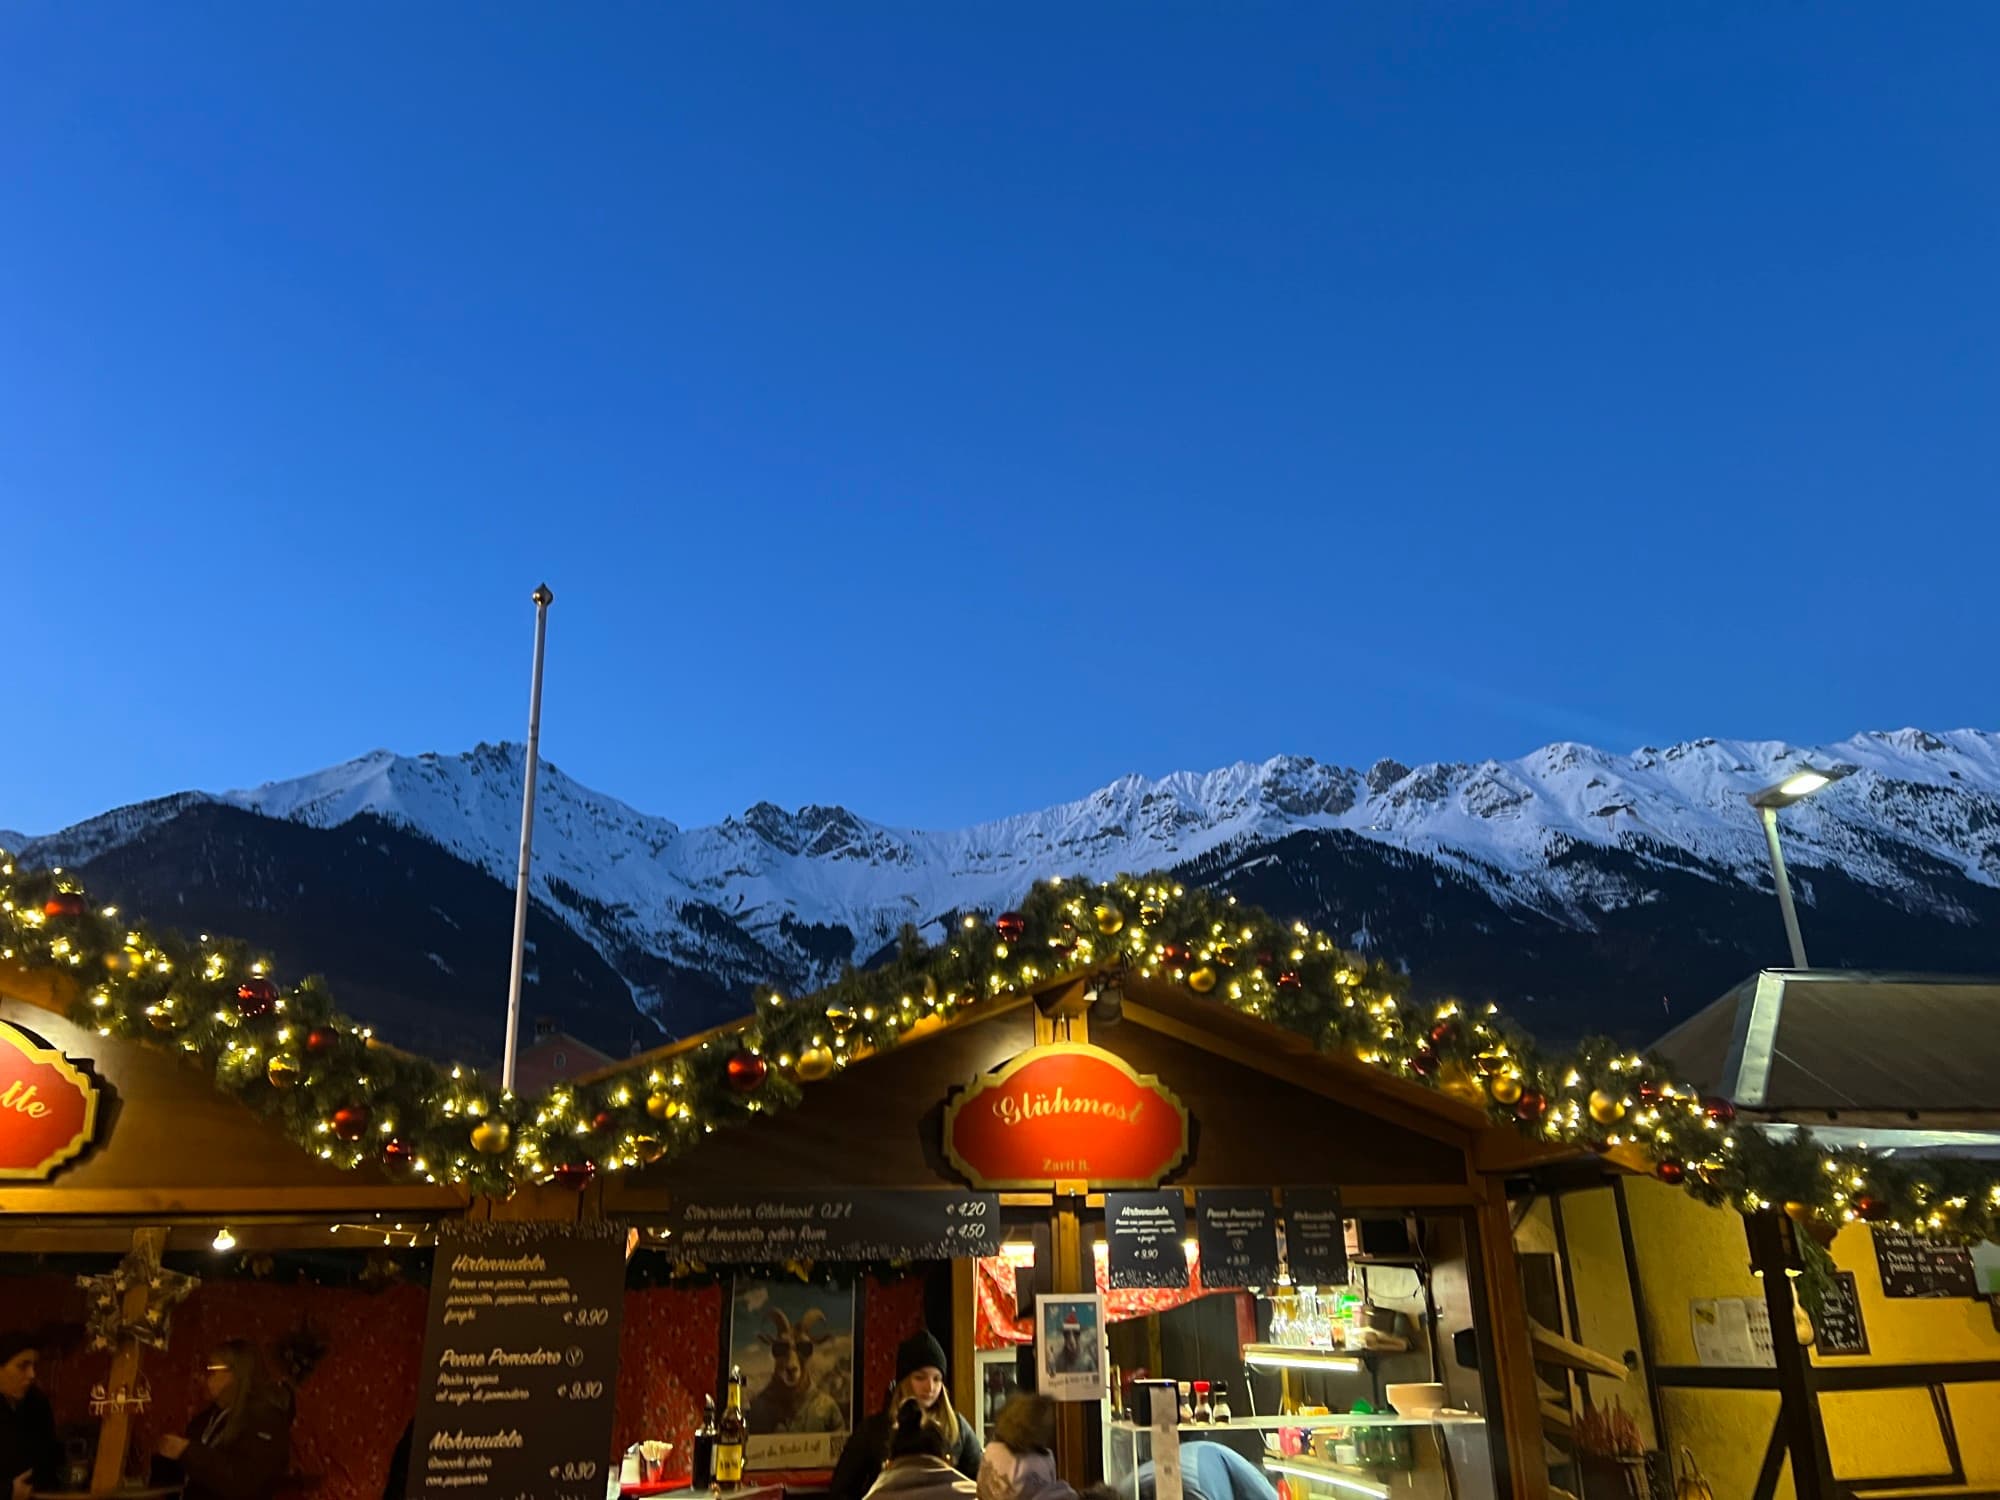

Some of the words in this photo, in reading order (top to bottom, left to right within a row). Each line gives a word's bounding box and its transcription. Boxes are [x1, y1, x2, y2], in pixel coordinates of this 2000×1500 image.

[0, 1080, 53, 1118] tte
[992, 1086, 1144, 1126] Glühmost
[799, 1225, 828, 1242] Rum
[452, 1254, 546, 1271] Hirtennudeln
[439, 1348, 485, 1367] Penne
[488, 1346, 562, 1366] Pomodoro
[429, 1429, 524, 1450] Mohnnudeln
